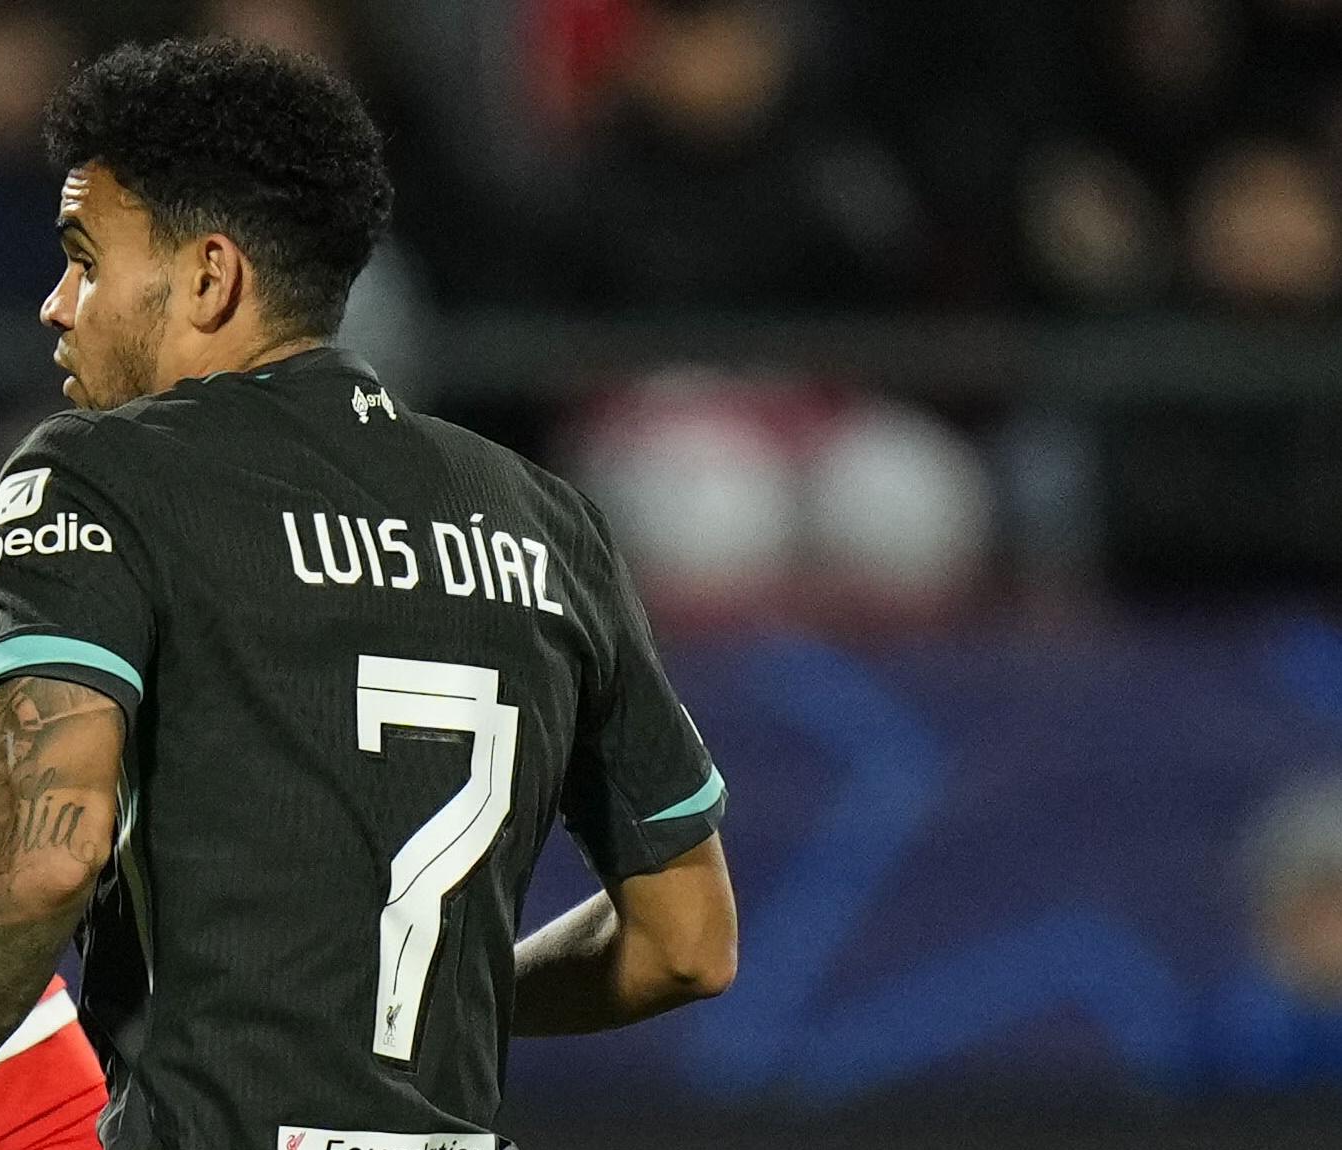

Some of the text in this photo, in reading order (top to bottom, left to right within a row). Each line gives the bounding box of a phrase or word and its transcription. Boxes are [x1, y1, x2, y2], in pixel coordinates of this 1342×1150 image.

[366, 394, 381, 407] 97
[282, 511, 564, 616] LUIS DÍAZ
[357, 654, 519, 1062] 7
